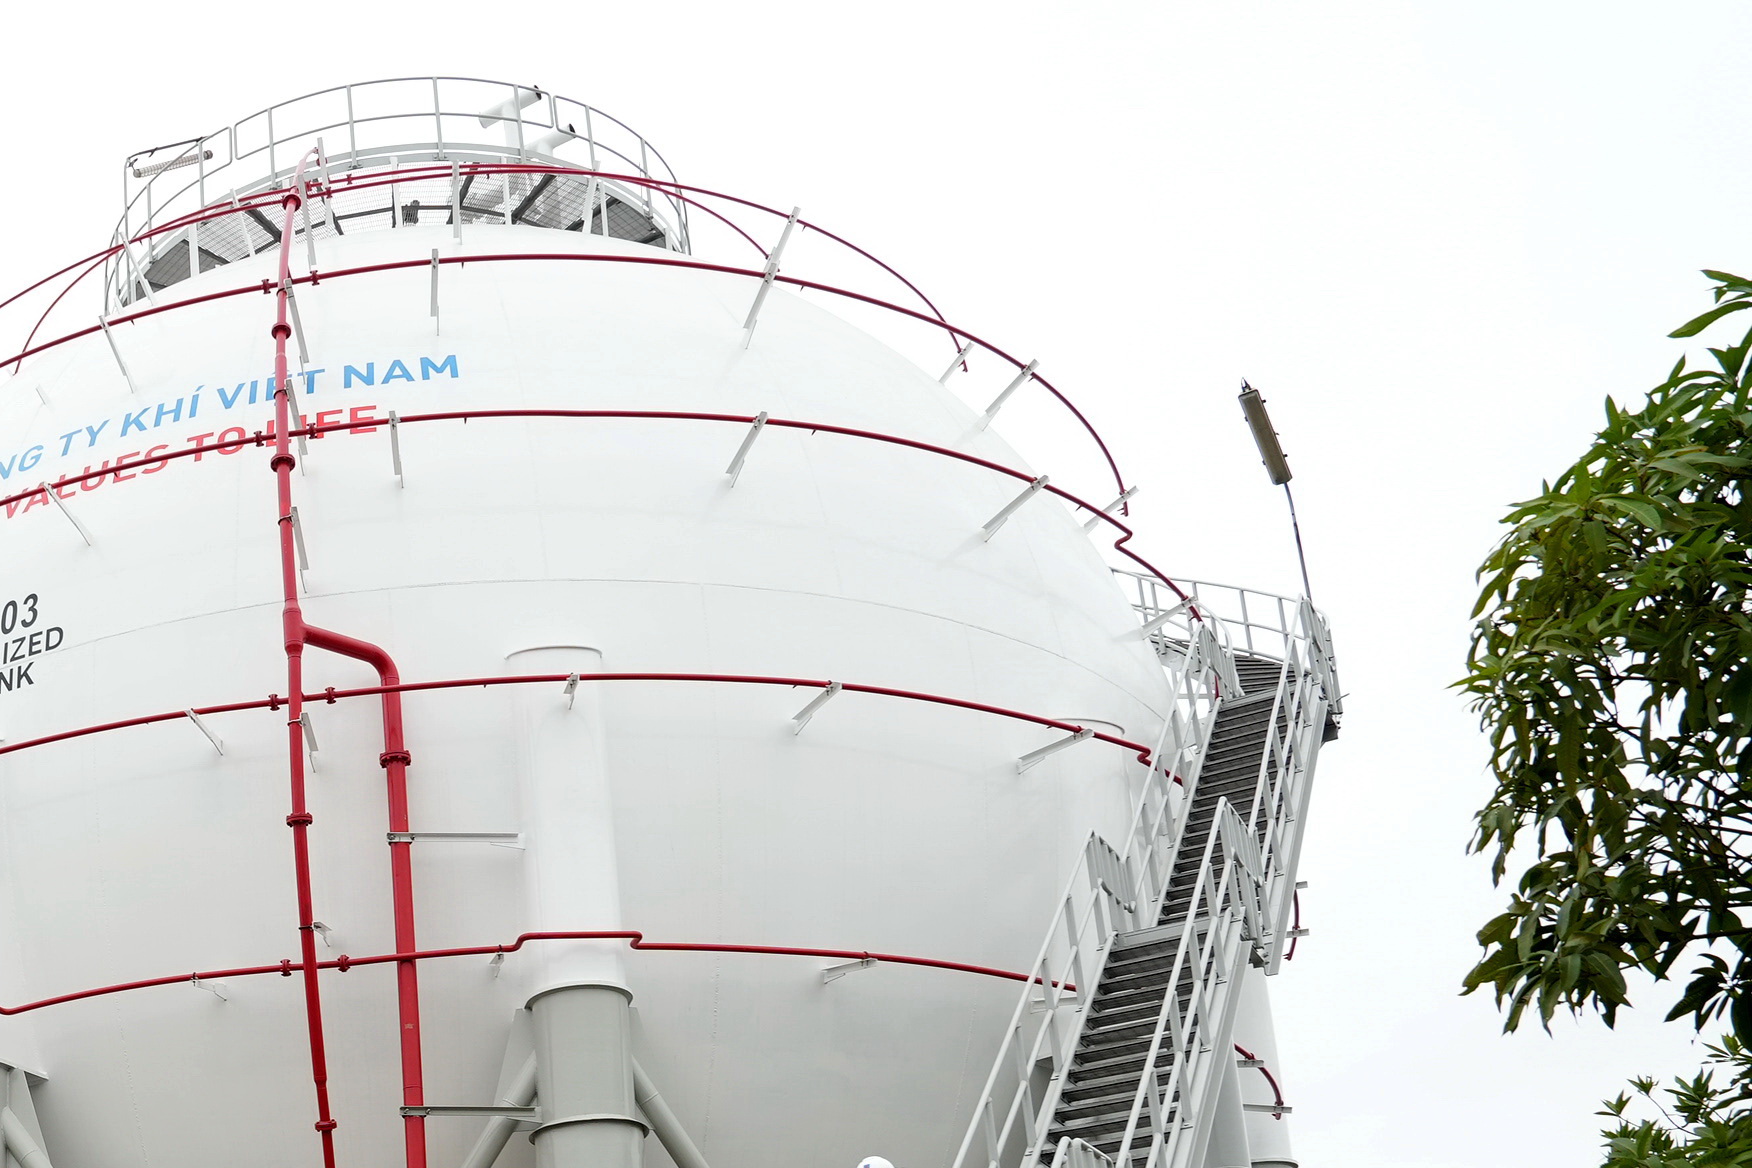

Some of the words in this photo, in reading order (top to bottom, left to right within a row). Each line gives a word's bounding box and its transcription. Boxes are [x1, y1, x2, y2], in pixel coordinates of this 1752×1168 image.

[59, 418, 110, 457] TY
[119, 384, 205, 438] KHÍ
[343, 354, 460, 389] NAM
[5, 444, 170, 519] VALUES
[187, 426, 246, 462] TO
